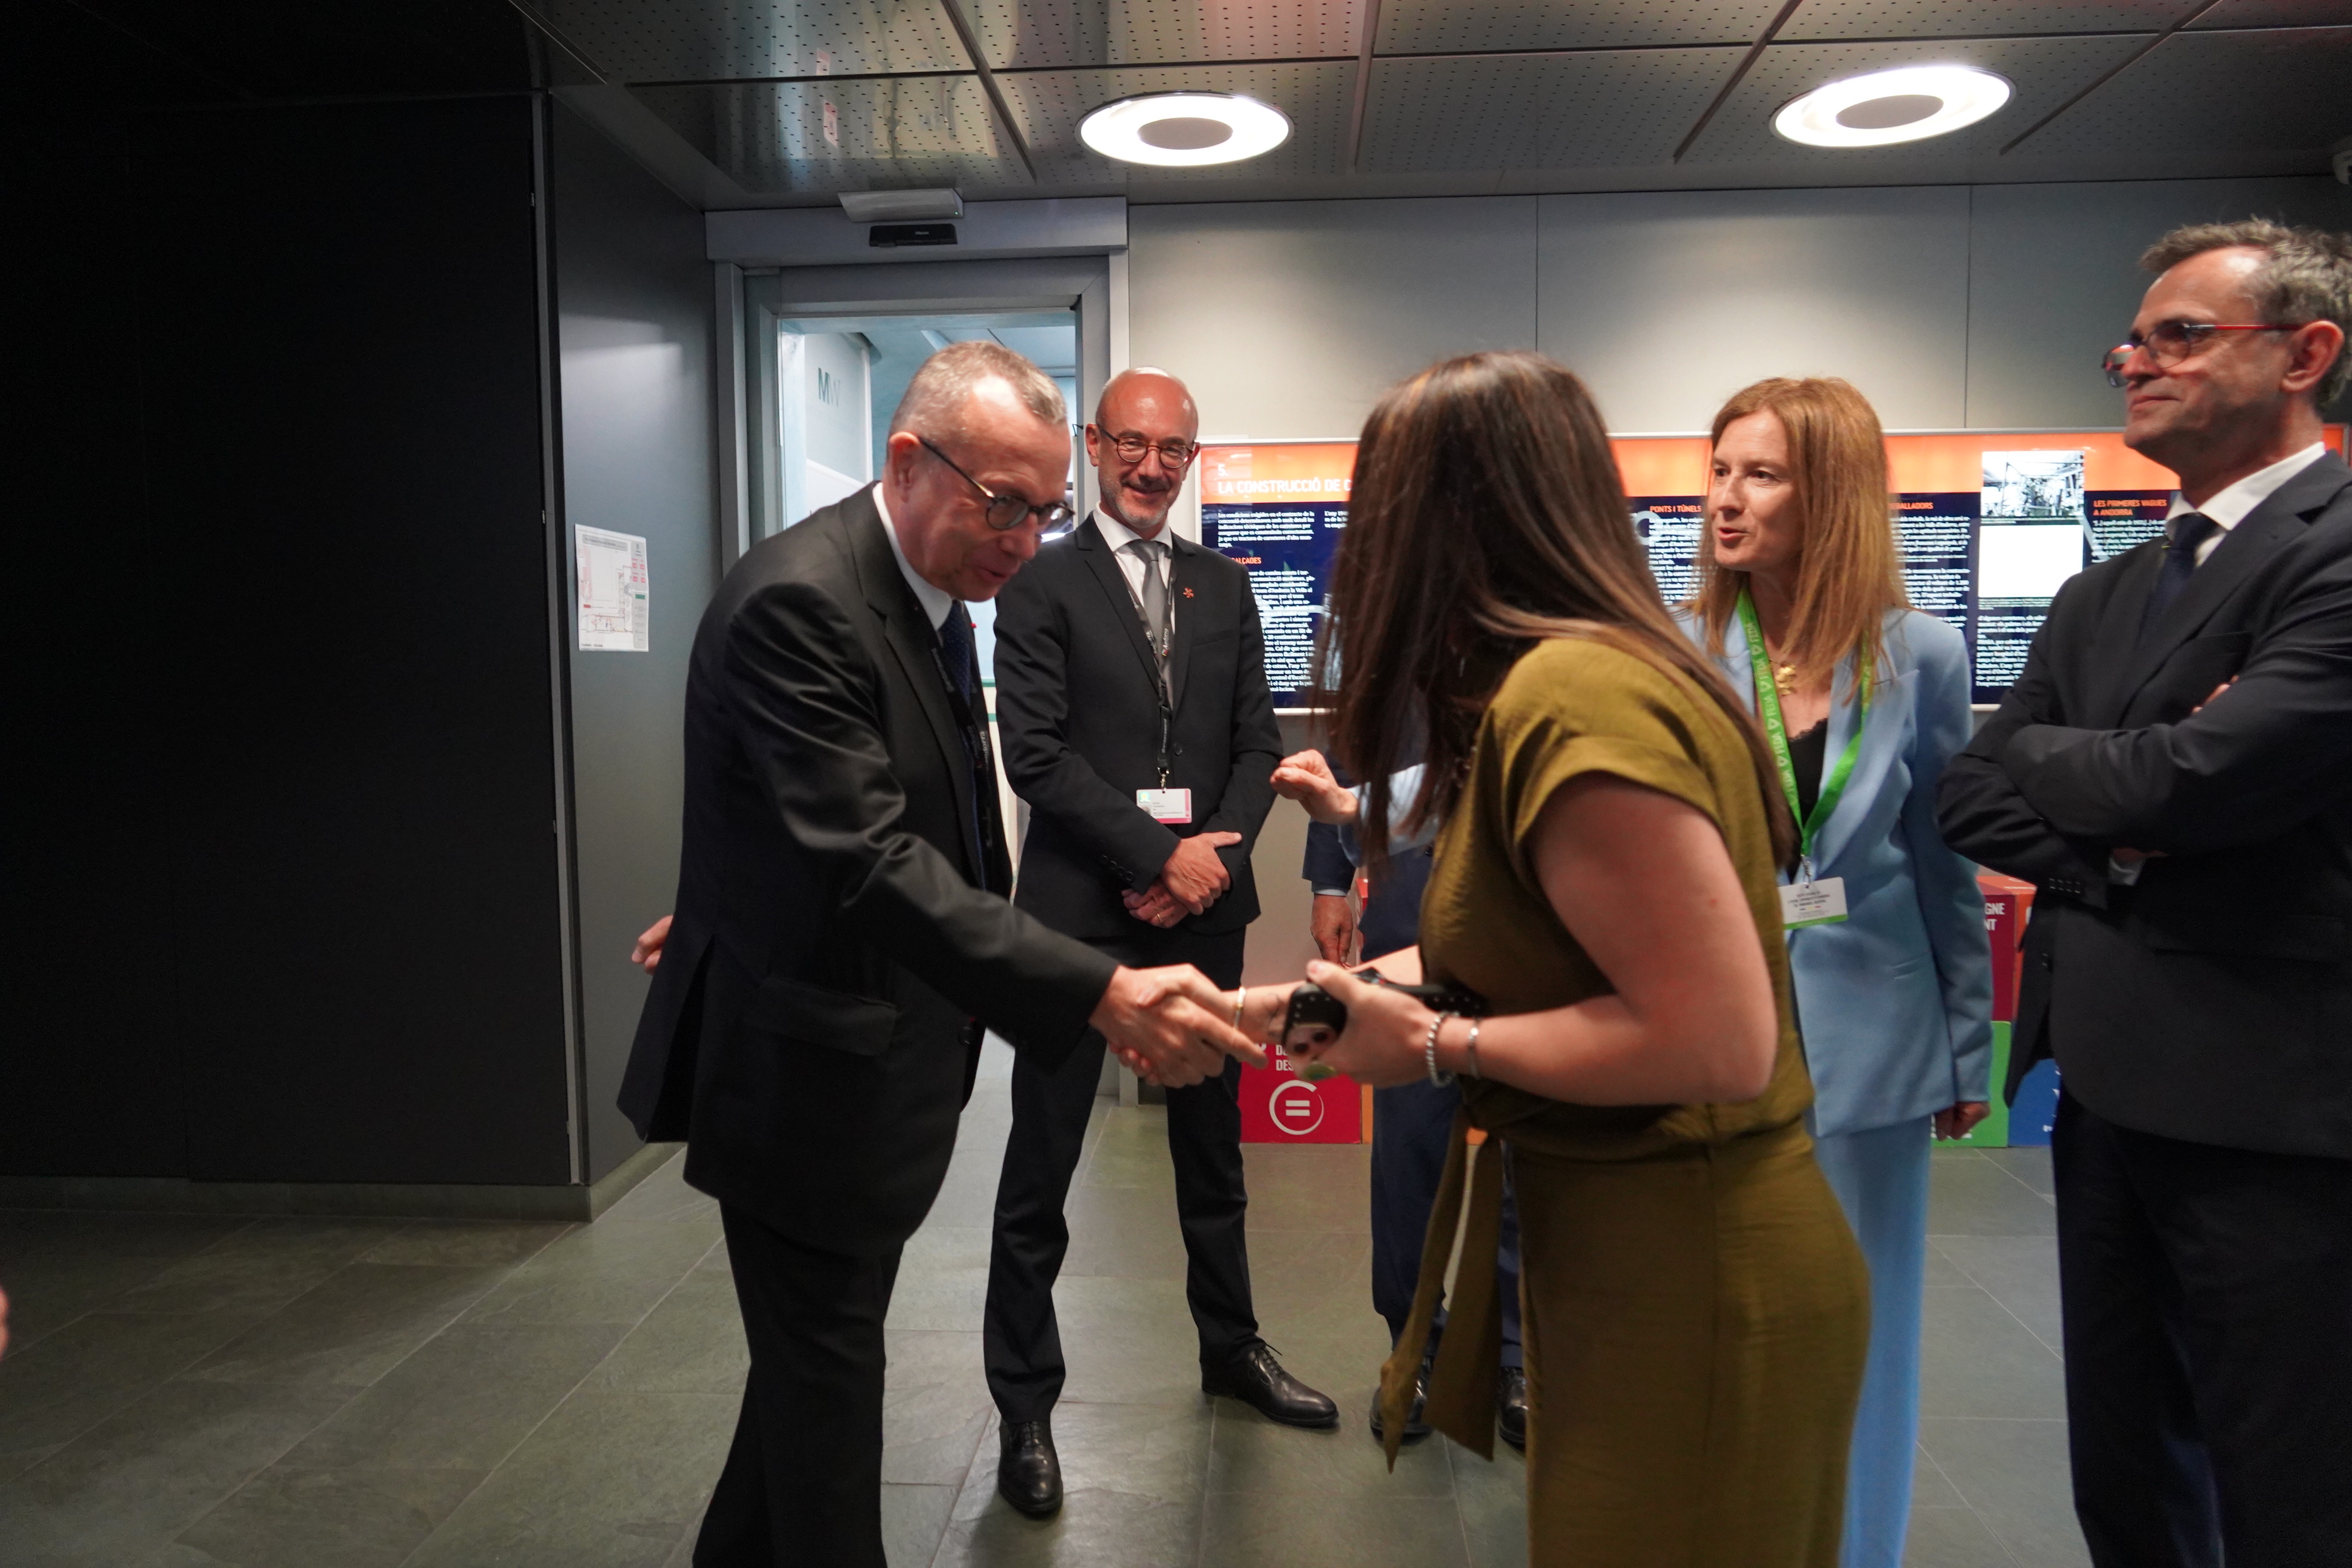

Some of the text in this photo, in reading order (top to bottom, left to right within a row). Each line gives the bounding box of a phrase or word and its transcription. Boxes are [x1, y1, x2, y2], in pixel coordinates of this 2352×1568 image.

[1218, 481, 1233, 494] LA
[1237, 477, 1321, 494] CONSTRUCCIÓ
[1324, 479, 1340, 492] DE
[1984, 902, 2005, 915] GNE
[1984, 918, 1997, 931] NT
